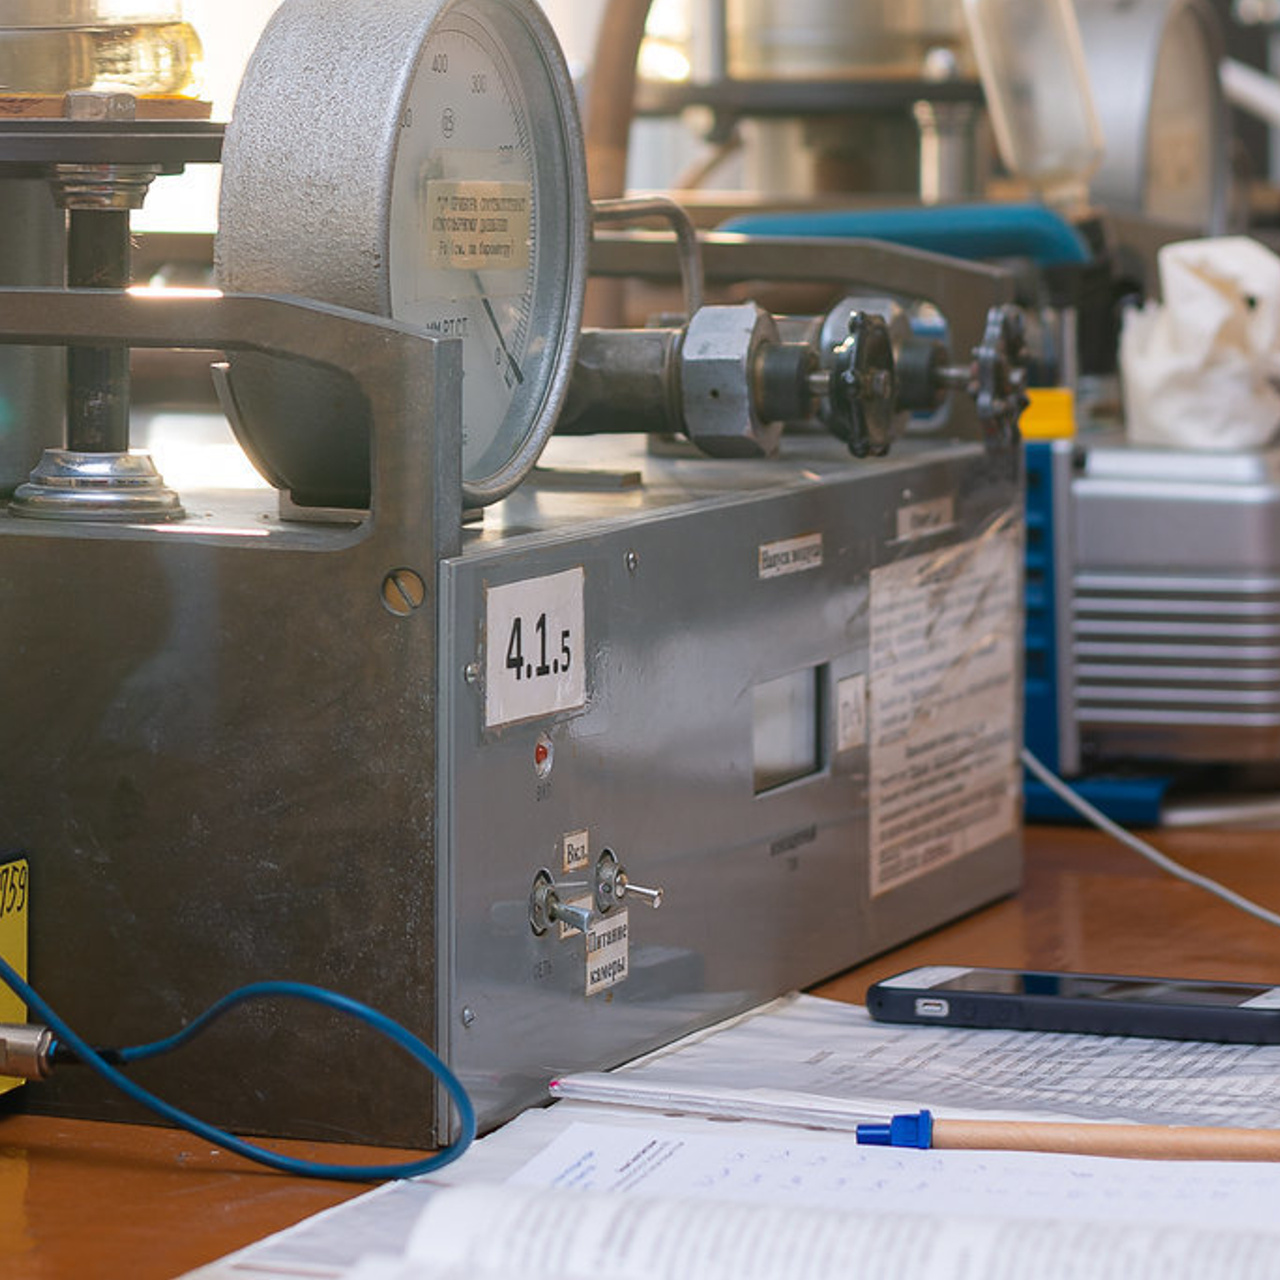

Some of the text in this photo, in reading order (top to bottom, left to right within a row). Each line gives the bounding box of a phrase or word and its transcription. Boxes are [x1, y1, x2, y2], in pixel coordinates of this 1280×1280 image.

[432, 54, 448, 73] 400
[471, 74, 486, 94] 300
[506, 613, 571, 680] 4.1.5
[588, 924, 628, 954] Питание
[590, 956, 626, 986] камеры
